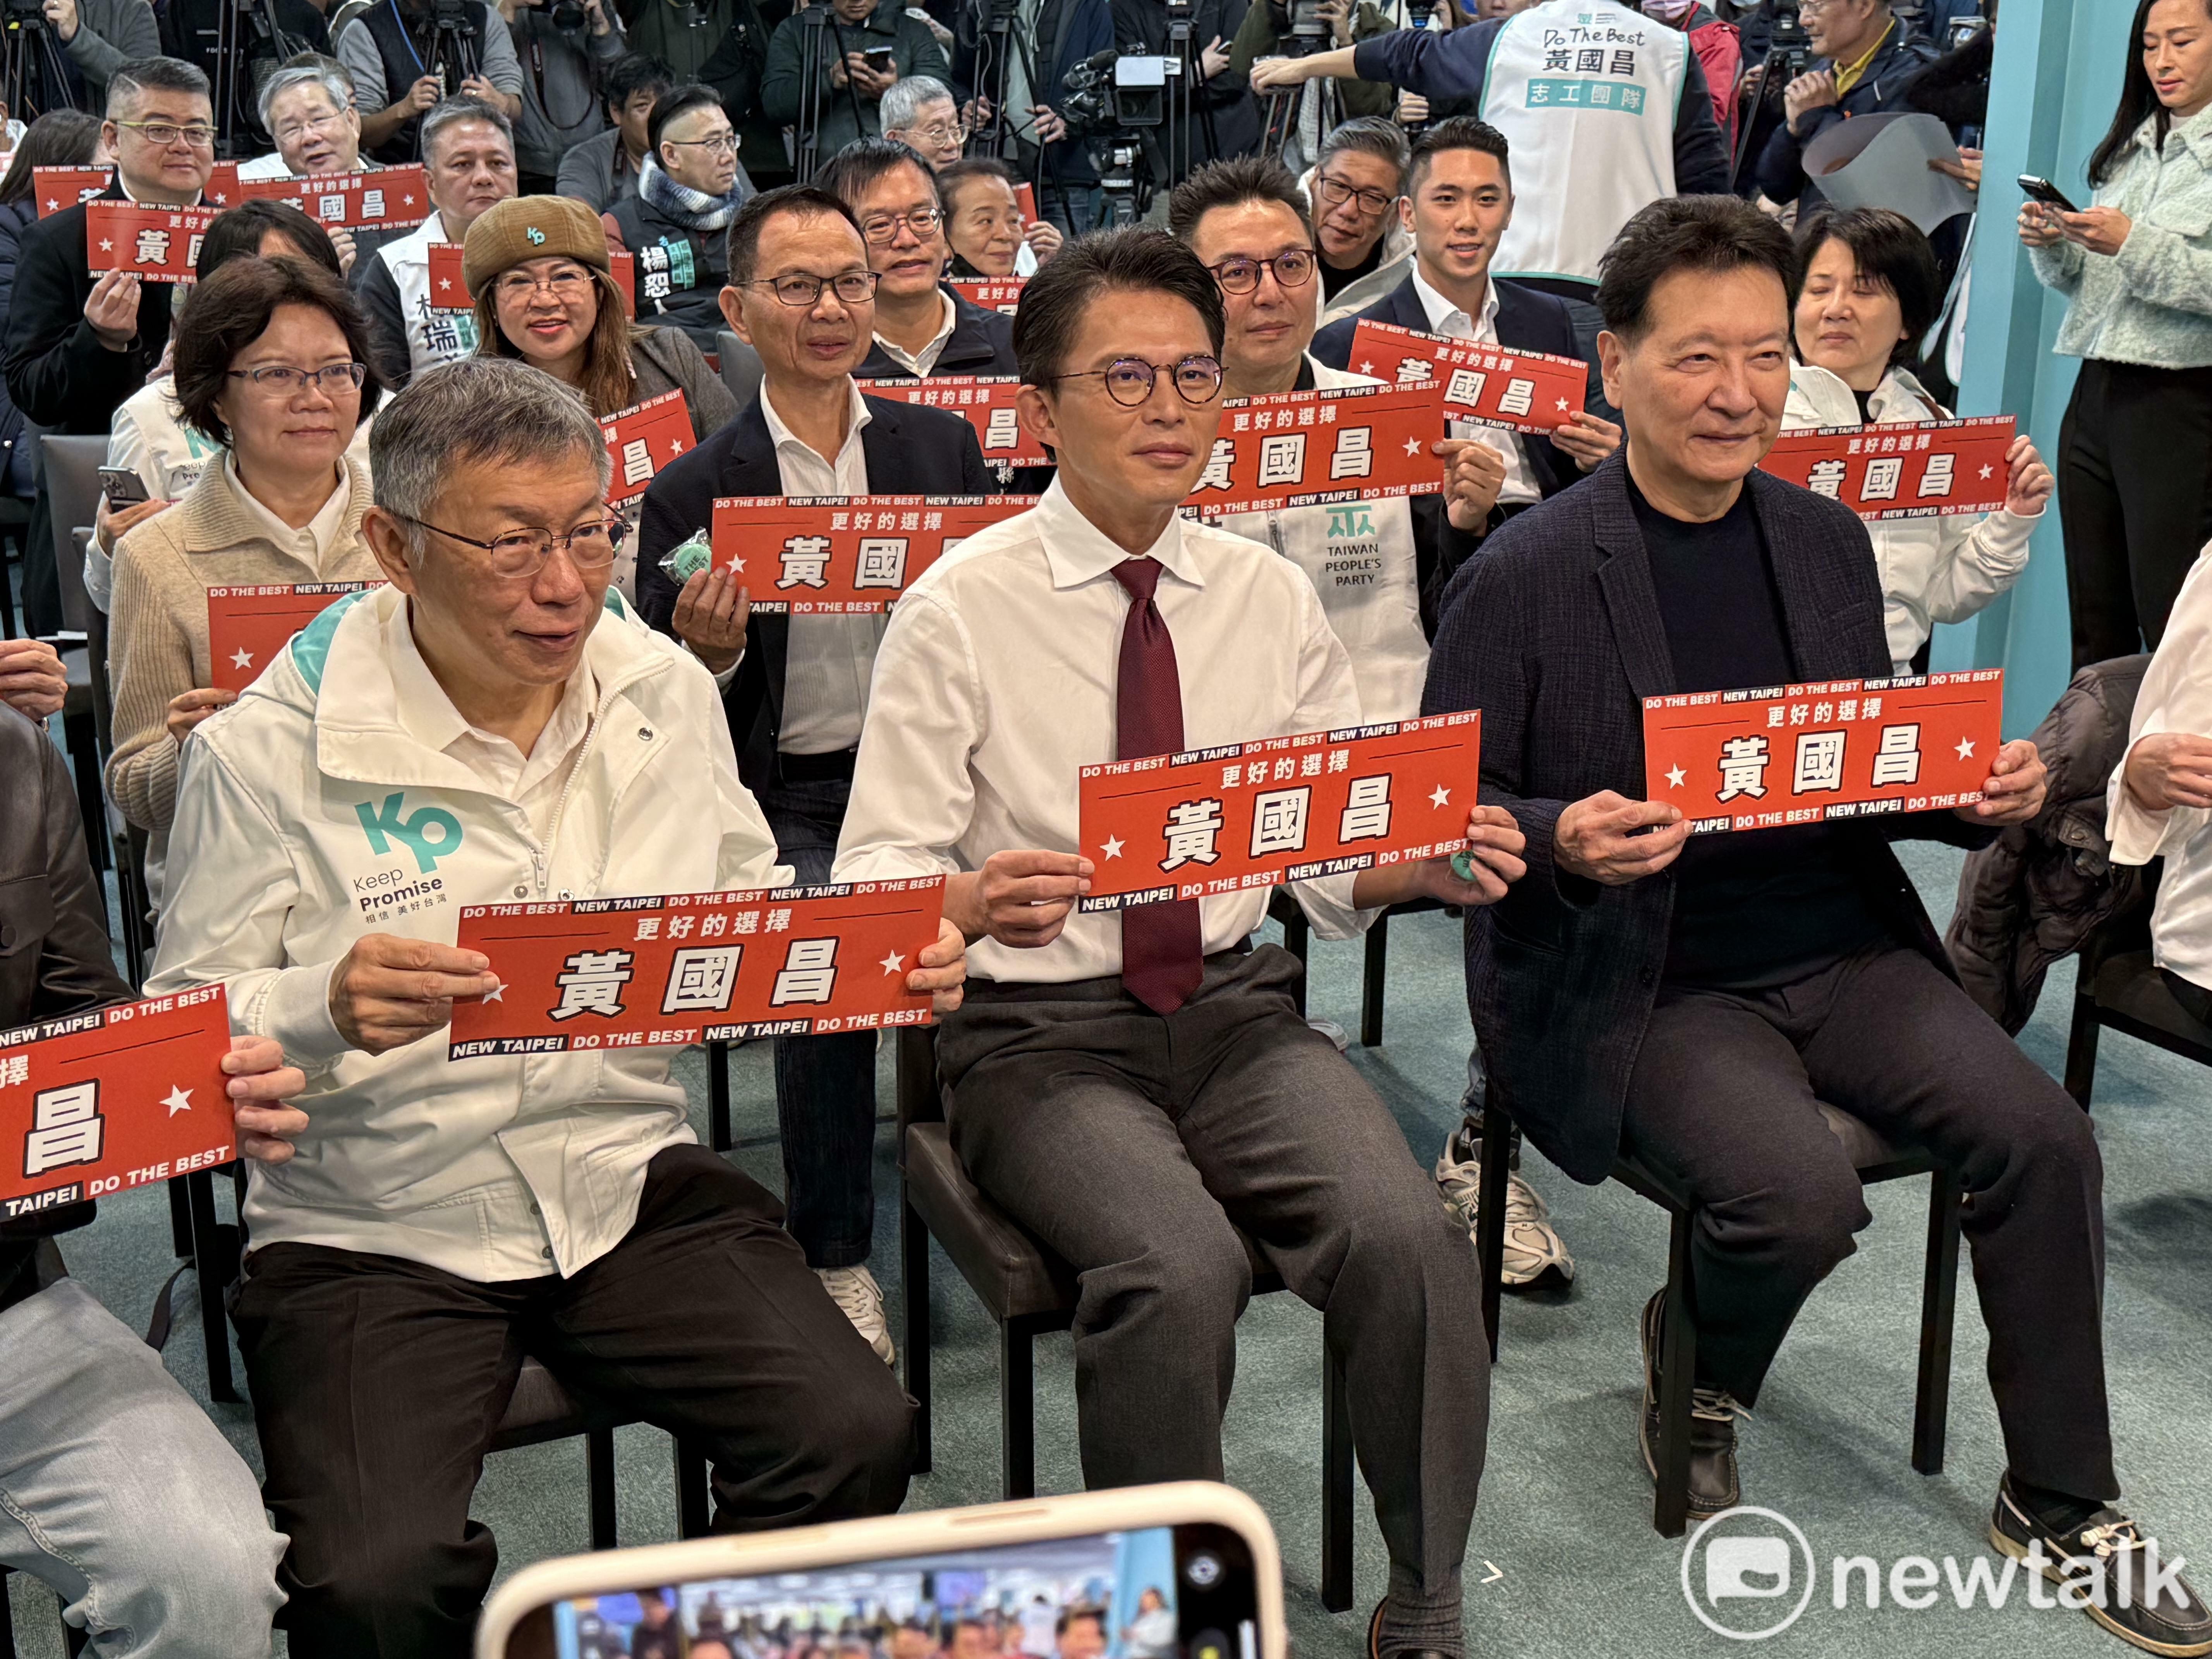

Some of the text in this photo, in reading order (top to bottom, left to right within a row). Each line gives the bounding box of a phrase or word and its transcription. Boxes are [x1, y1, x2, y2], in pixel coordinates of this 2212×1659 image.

[1544, 27, 1646, 48] Do The Best
[1542, 49, 1635, 77] 黃國昌
[1530, 82, 1643, 110] 志工團隊
[1434, 346, 1513, 373] 更好的選擇
[908, 389, 990, 405] 更好的選擇
[1396, 357, 1536, 416] 黃國昌
[601, 389, 680, 424] NEW TAIPEI DO THE BEST
[1233, 405, 1337, 433] 更好的選擇
[985, 409, 1018, 449] 昌
[1846, 434, 1931, 455] 更好的選擇
[623, 438, 655, 487] 昌
[1807, 453, 1956, 501] 黃國昌
[1204, 481, 1441, 515] DO THE BEST NEW TAIPEI DO THE BEST
[1882, 501, 2003, 519] NEW TAIPEI DO THE BEST
[830, 512, 943, 531] 更好的選擇
[684, 555, 701, 573] THE
[776, 537, 965, 589] 黃國
[1327, 543, 1379, 556] TAIWAN
[210, 582, 362, 597] DO THE BEST NEW TAIPEI
[1336, 573, 1375, 586] PARTY
[794, 602, 812, 612] DO
[816, 602, 843, 612] THE
[846, 602, 881, 612] BEST
[1646, 670, 2001, 709] DO THE BEST NEW TAIPEI DO THE BEST NEW TAIPEI DO THE BEST
[1767, 697, 1882, 728] 更好的選擇
[1082, 713, 1476, 778] DO THE BEST NEW TAIPEI DO THE BEST NEW TAIPEI DO THE BEST
[1716, 724, 1920, 801] 黃國昌
[1220, 749, 1350, 789] 更好的選擇
[1159, 776, 1391, 871] 黃國昌
[1736, 815, 1754, 828] DO
[1757, 811, 1783, 825] THE
[1786, 807, 1820, 822] BEST
[1826, 804, 1856, 817] NEW
[1859, 799, 1902, 814] TAIPEI
[1908, 797, 1927, 809] DO
[1930, 794, 1956, 807] THE
[1958, 791, 1987, 804] BES
[354, 867, 403, 892] Keep
[1082, 895, 1120, 911] NEW
[1123, 887, 1174, 906] TAIPEI
[1181, 883, 1203, 898] DO
[1207, 877, 1238, 893] THE
[1242, 870, 1281, 888] BEST
[1288, 863, 1322, 880] NEW
[1325, 855, 1372, 873] TAIPEI
[1379, 850, 1400, 865] DO
[1403, 845, 1432, 860] THE
[1434, 838, 1467, 860] BEST
[359, 876, 443, 912] Promise
[365, 894, 448, 924] 相信 美好台灣
[463, 876, 943, 918] DO THE BEST NEW TAIPEI DO THE BEST NEW TAIPEI DO THE BEST
[634, 908, 792, 941] 更好的選擇
[549, 940, 836, 1019] 黃國昌
[0, 987, 220, 1046] NEW TAIPEI DO THE BEST
[452, 1008, 927, 1058] NEW TAIPEI DO THE BEST NEW TAIPEI DO THE BEST
[0, 1054, 28, 1089] 擇
[26, 1082, 101, 1175] 昌
[5, 1145, 229, 1216] TAIPEI DO THE BEST
